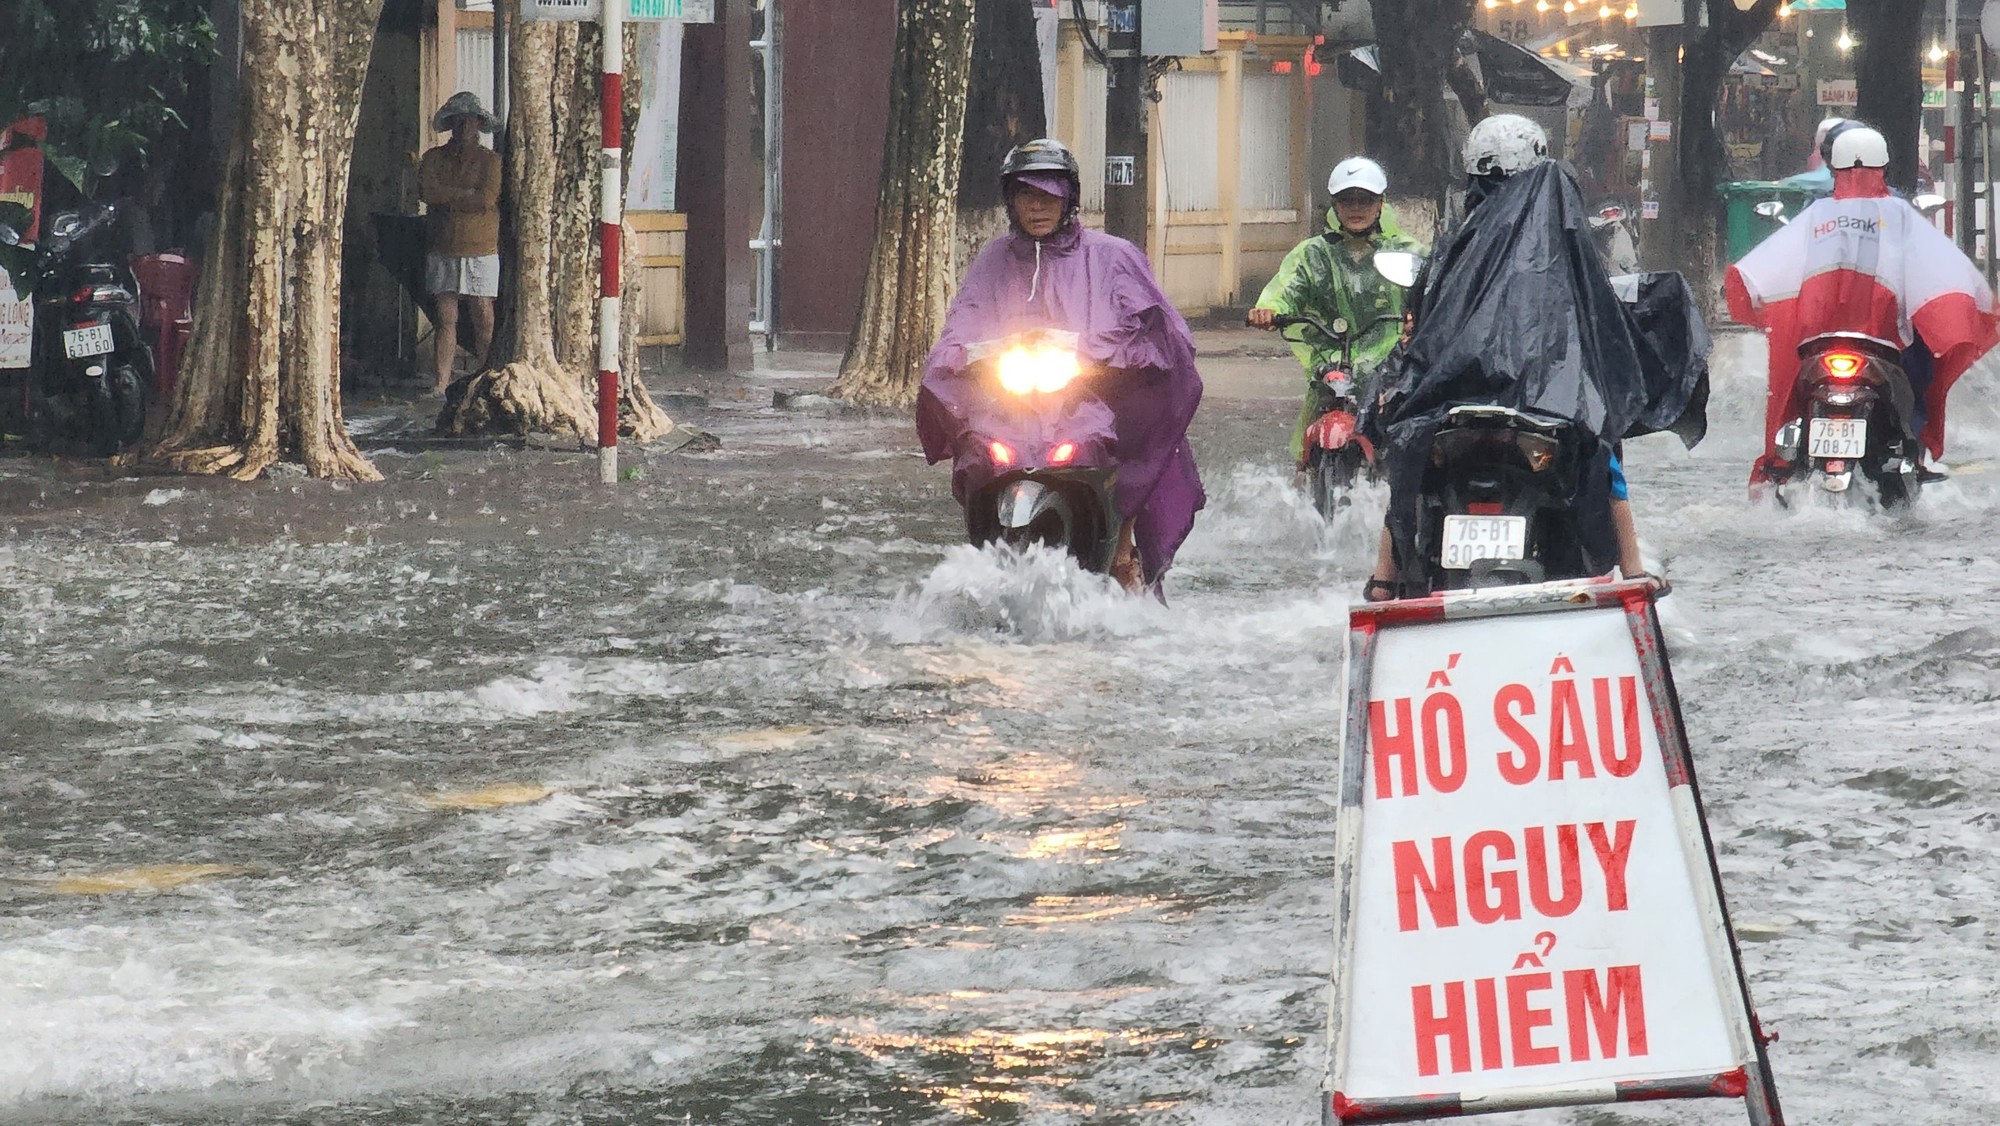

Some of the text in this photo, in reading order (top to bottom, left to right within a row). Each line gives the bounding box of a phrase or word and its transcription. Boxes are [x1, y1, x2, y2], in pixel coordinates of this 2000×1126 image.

[1814, 216, 1876, 238] HDBank
[71, 328, 102, 344] 76-B1
[69, 340, 110, 358] 631.60
[1820, 423, 1855, 438] 76-B1
[1813, 440, 1859, 454] 708.71
[1458, 520, 1510, 541] 76-B1
[1368, 652, 1643, 800] HỐ SÂU
[1392, 819, 1637, 932] NGUY
[1411, 931, 1648, 1077] HIỂM
